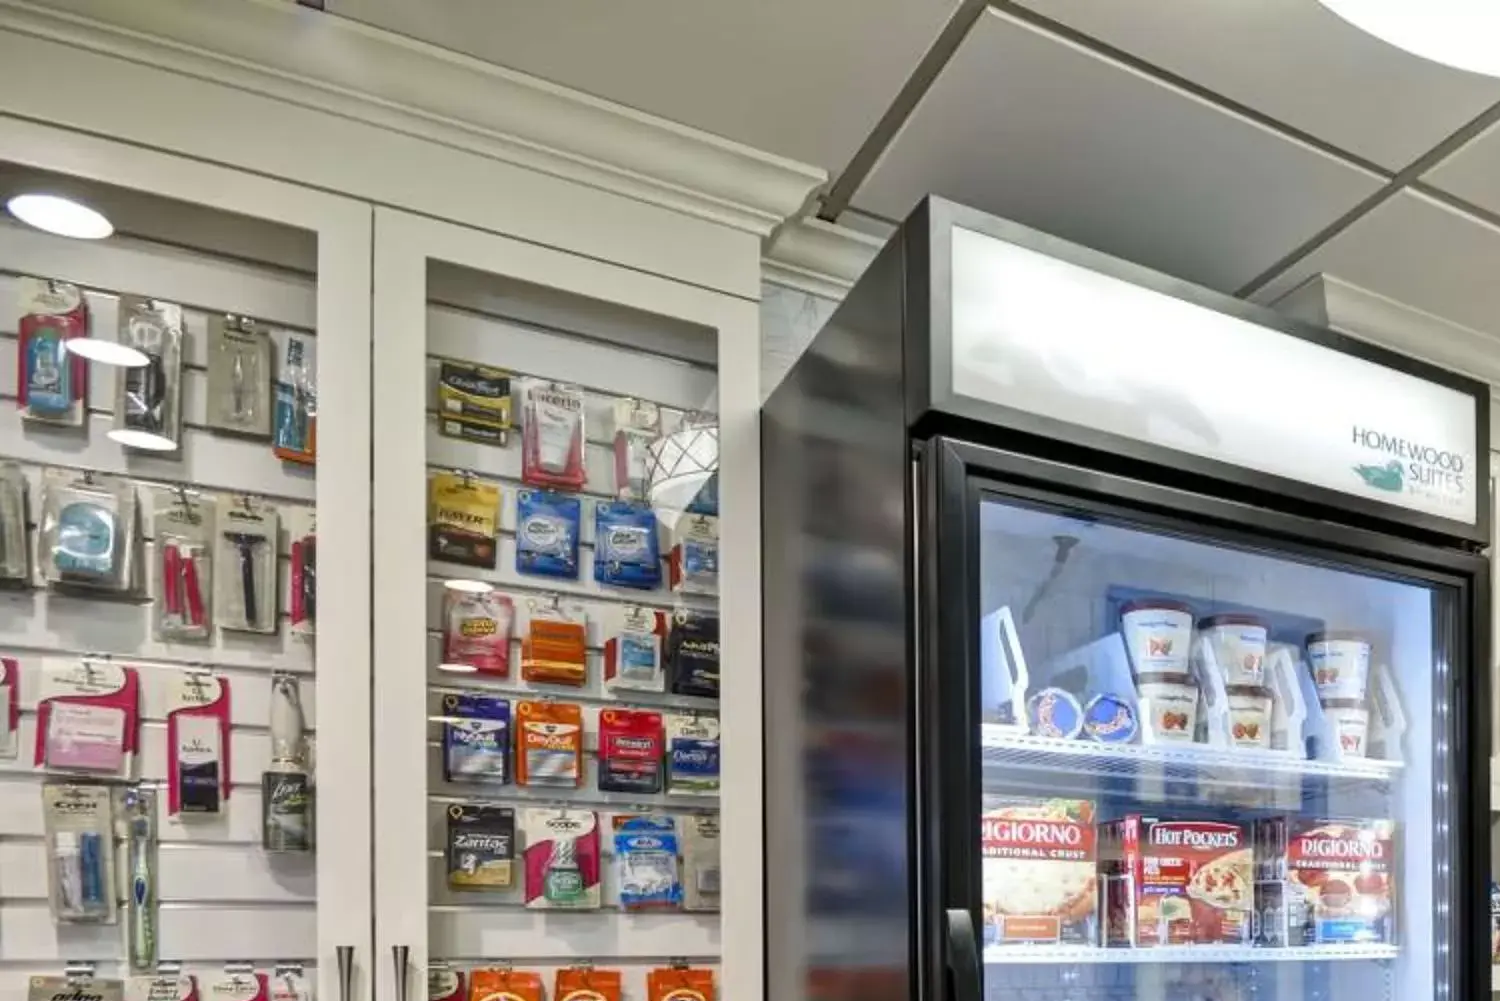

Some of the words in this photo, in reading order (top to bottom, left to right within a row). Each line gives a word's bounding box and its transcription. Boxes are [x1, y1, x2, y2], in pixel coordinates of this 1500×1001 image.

[1351, 425, 1465, 473] HOMEWOOD
[1408, 463, 1465, 494] SUITES
[1155, 828, 1183, 846] HOT
[1183, 829, 1238, 848] POCKETS
